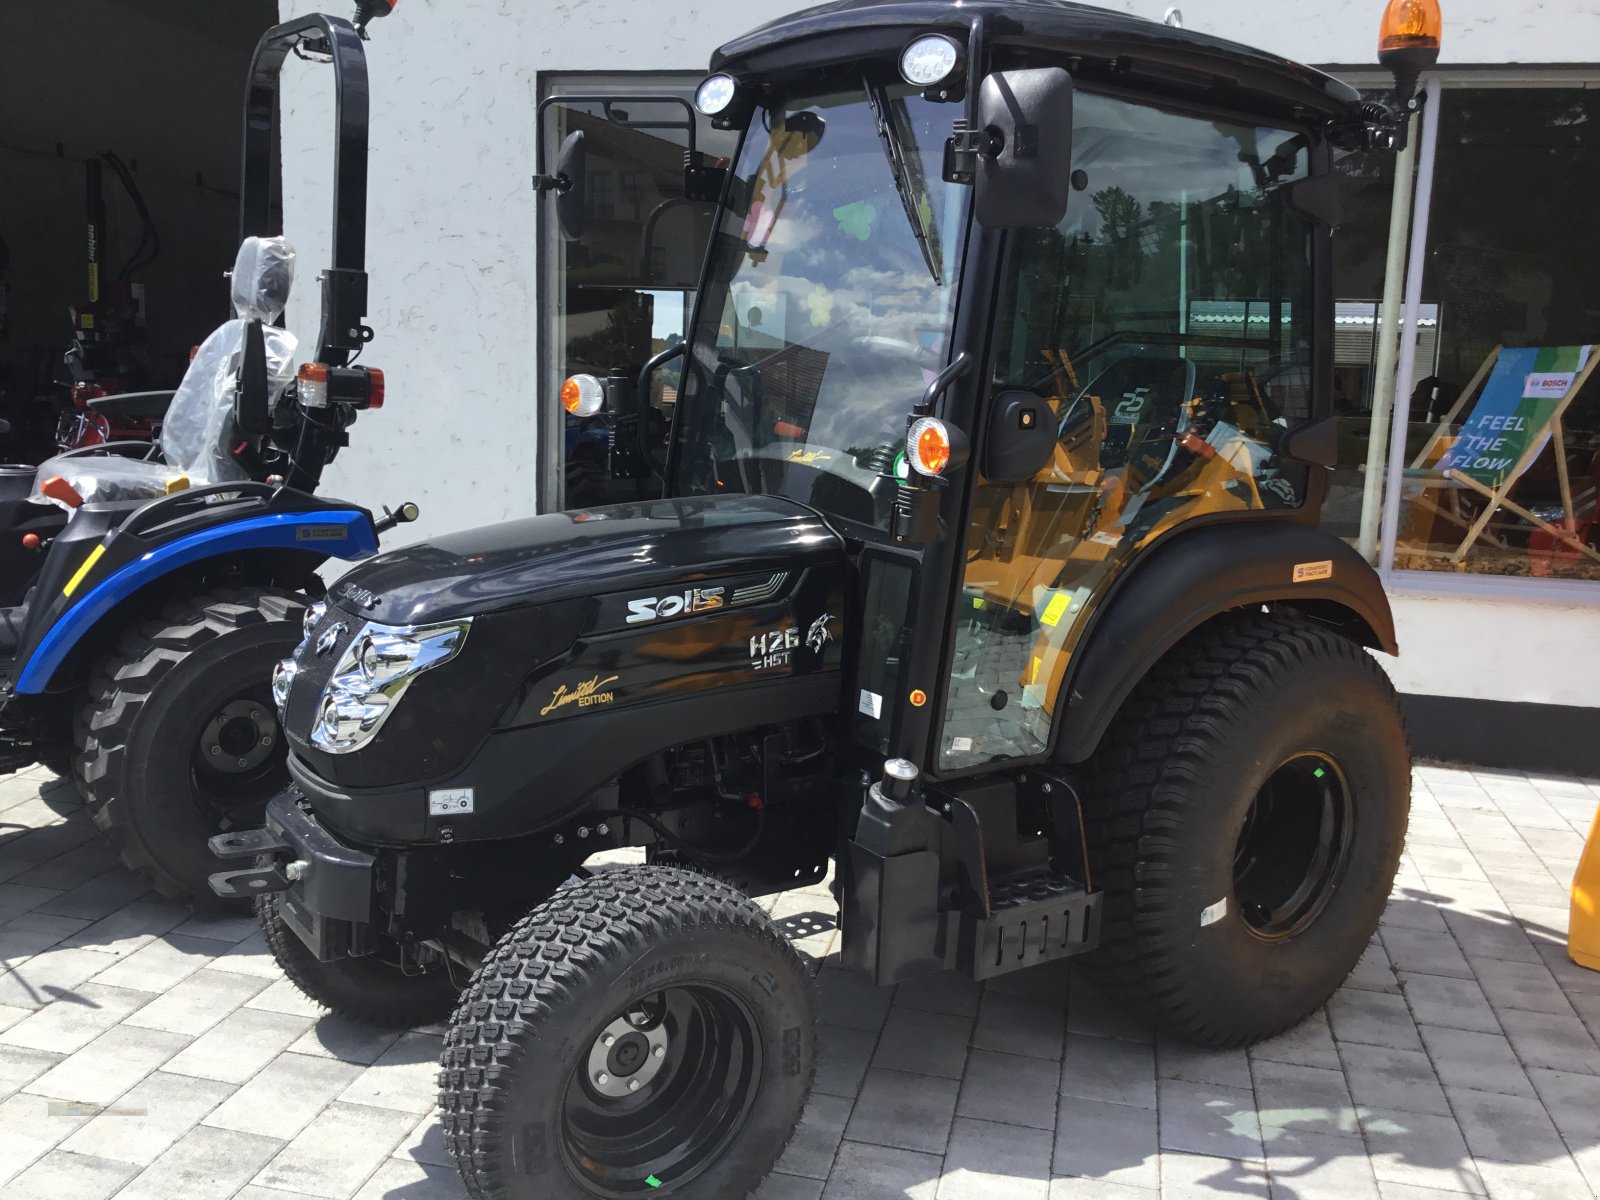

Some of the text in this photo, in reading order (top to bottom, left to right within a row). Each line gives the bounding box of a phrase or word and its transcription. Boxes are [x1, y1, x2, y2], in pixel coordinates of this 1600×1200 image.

[1541, 379, 1568, 387] BOSCH
[1477, 415, 1524, 432] FEEL
[1465, 435, 1507, 452] THE
[1449, 455, 1513, 470] FLOW
[540, 675, 619, 715] Limited
[578, 691, 614, 707] EDITION
